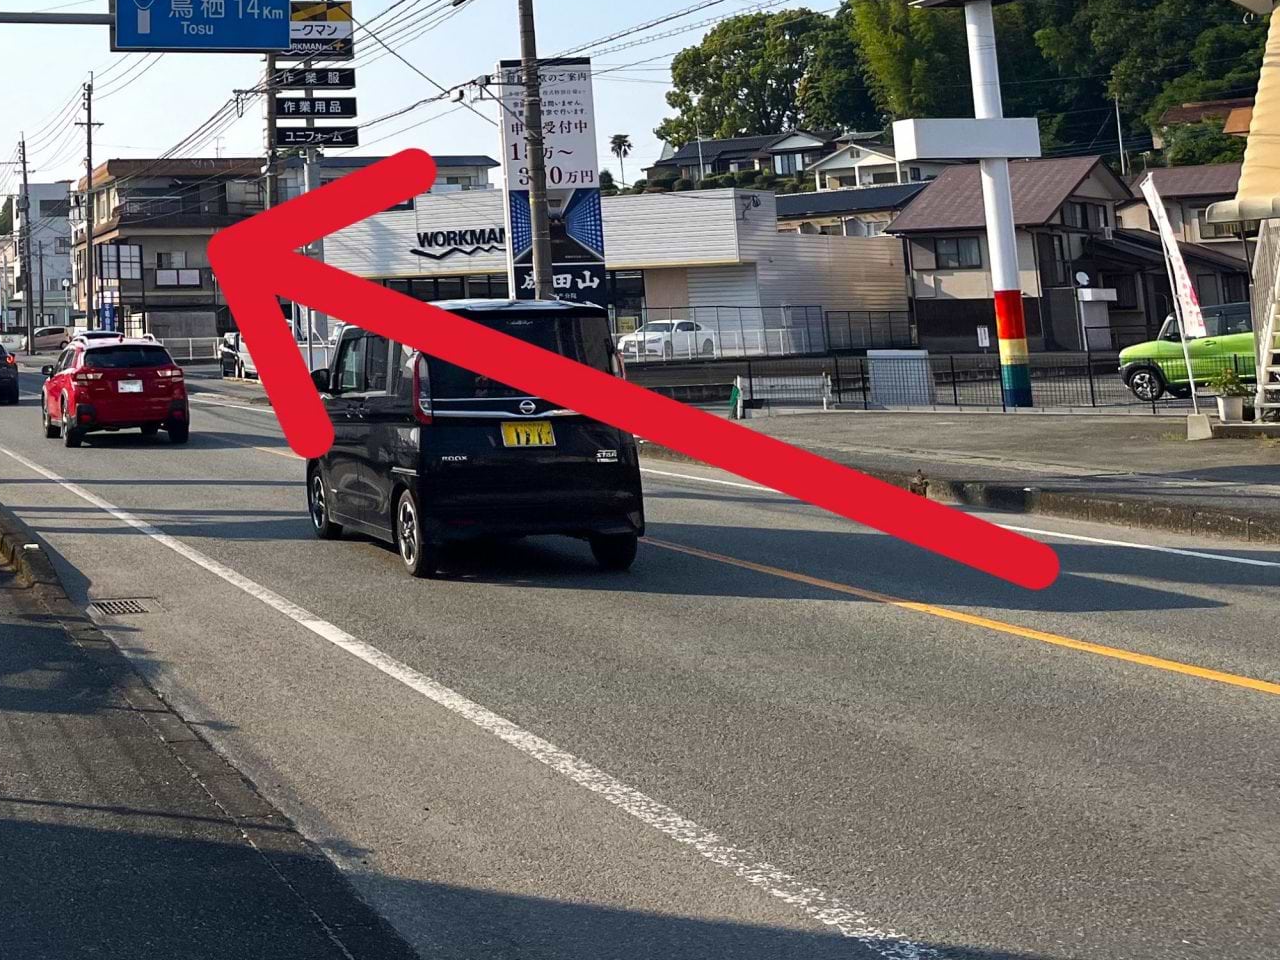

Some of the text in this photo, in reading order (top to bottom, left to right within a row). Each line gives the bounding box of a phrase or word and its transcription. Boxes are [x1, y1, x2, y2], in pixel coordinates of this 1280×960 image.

[181, 22, 214, 35] Tosu
[291, 24, 338, 36] ークマン
[289, 42, 322, 50] RKMAN
[283, 71, 340, 84] 作業服
[284, 100, 341, 113] 作業用品
[511, 120, 587, 136] 申受付中
[285, 131, 343, 142] ユニフォーム
[519, 166, 594, 186] 30万円
